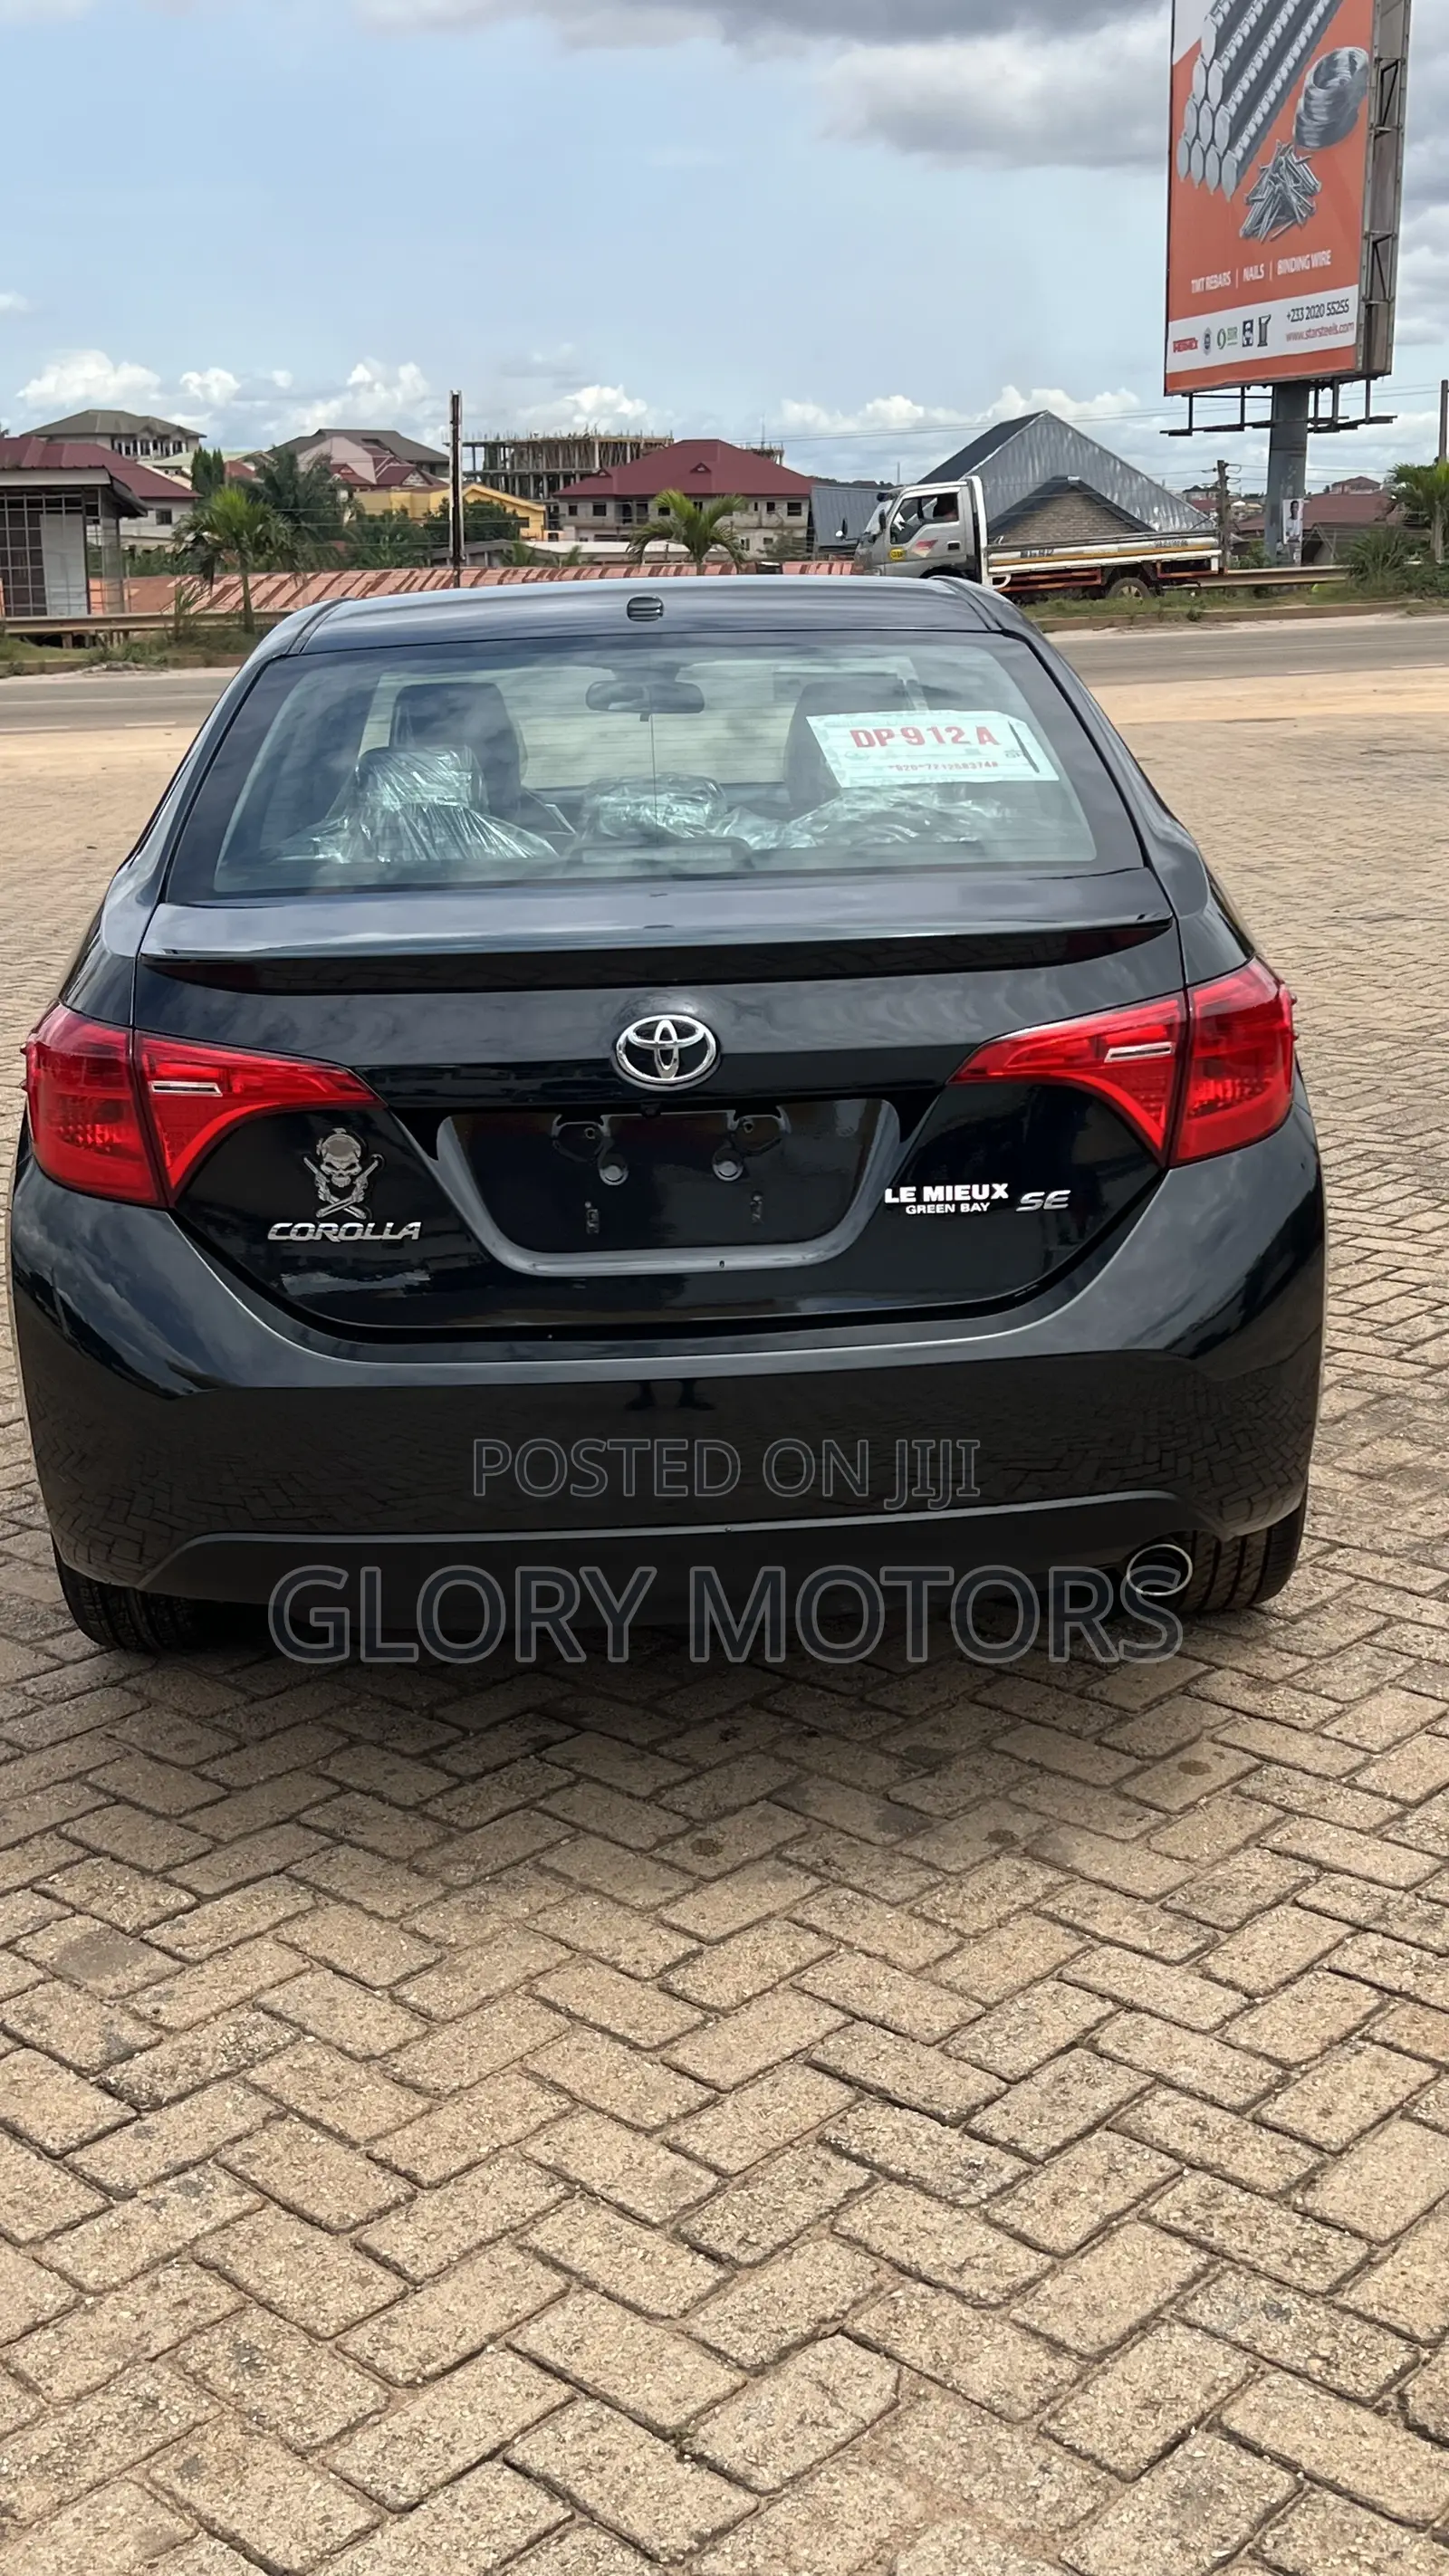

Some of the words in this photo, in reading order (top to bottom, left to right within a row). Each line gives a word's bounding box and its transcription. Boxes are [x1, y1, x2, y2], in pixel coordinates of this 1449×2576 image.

[1243, 263, 1265, 282] NAILS
[1277, 254, 1310, 275] BINDING
[1310, 249, 1332, 268] WIRE
[1205, 271, 1232, 292] REBARS
[1286, 307, 1304, 322] +233
[1305, 303, 1326, 321] 2020
[1327, 298, 1349, 316] 55255
[884, 1186, 916, 1203] LE
[923, 1183, 1009, 1202] MIEUX
[1015, 1190, 1071, 1211] SE
[906, 1203, 955, 1214] GREEN
[960, 1202, 991, 1213] BAY
[267, 1221, 422, 1242] COROLLA
